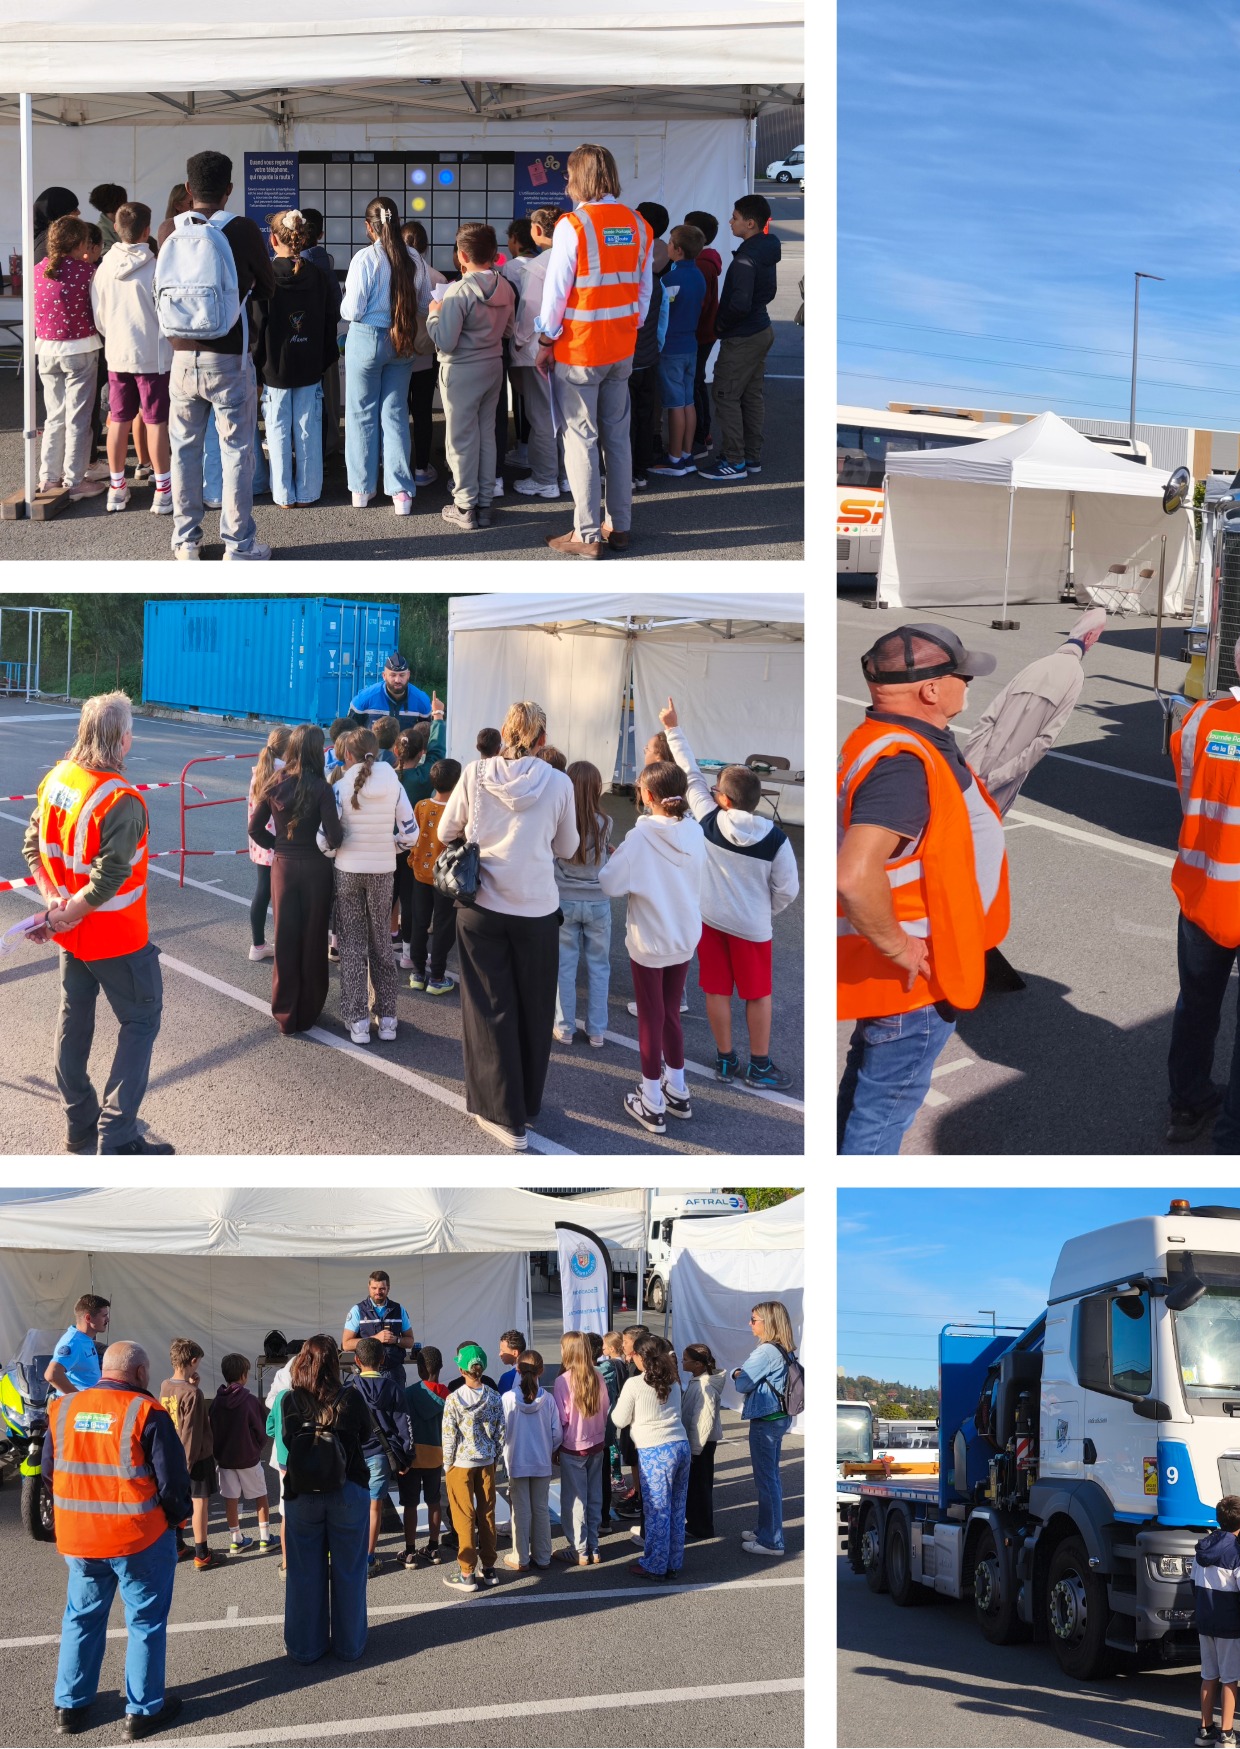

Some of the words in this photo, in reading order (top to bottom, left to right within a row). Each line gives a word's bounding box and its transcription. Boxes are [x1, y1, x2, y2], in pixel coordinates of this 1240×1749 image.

[274, 159, 294, 167] regardez
[1209, 732, 1232, 741] Journée
[1166, 1466, 1179, 1485] 9
